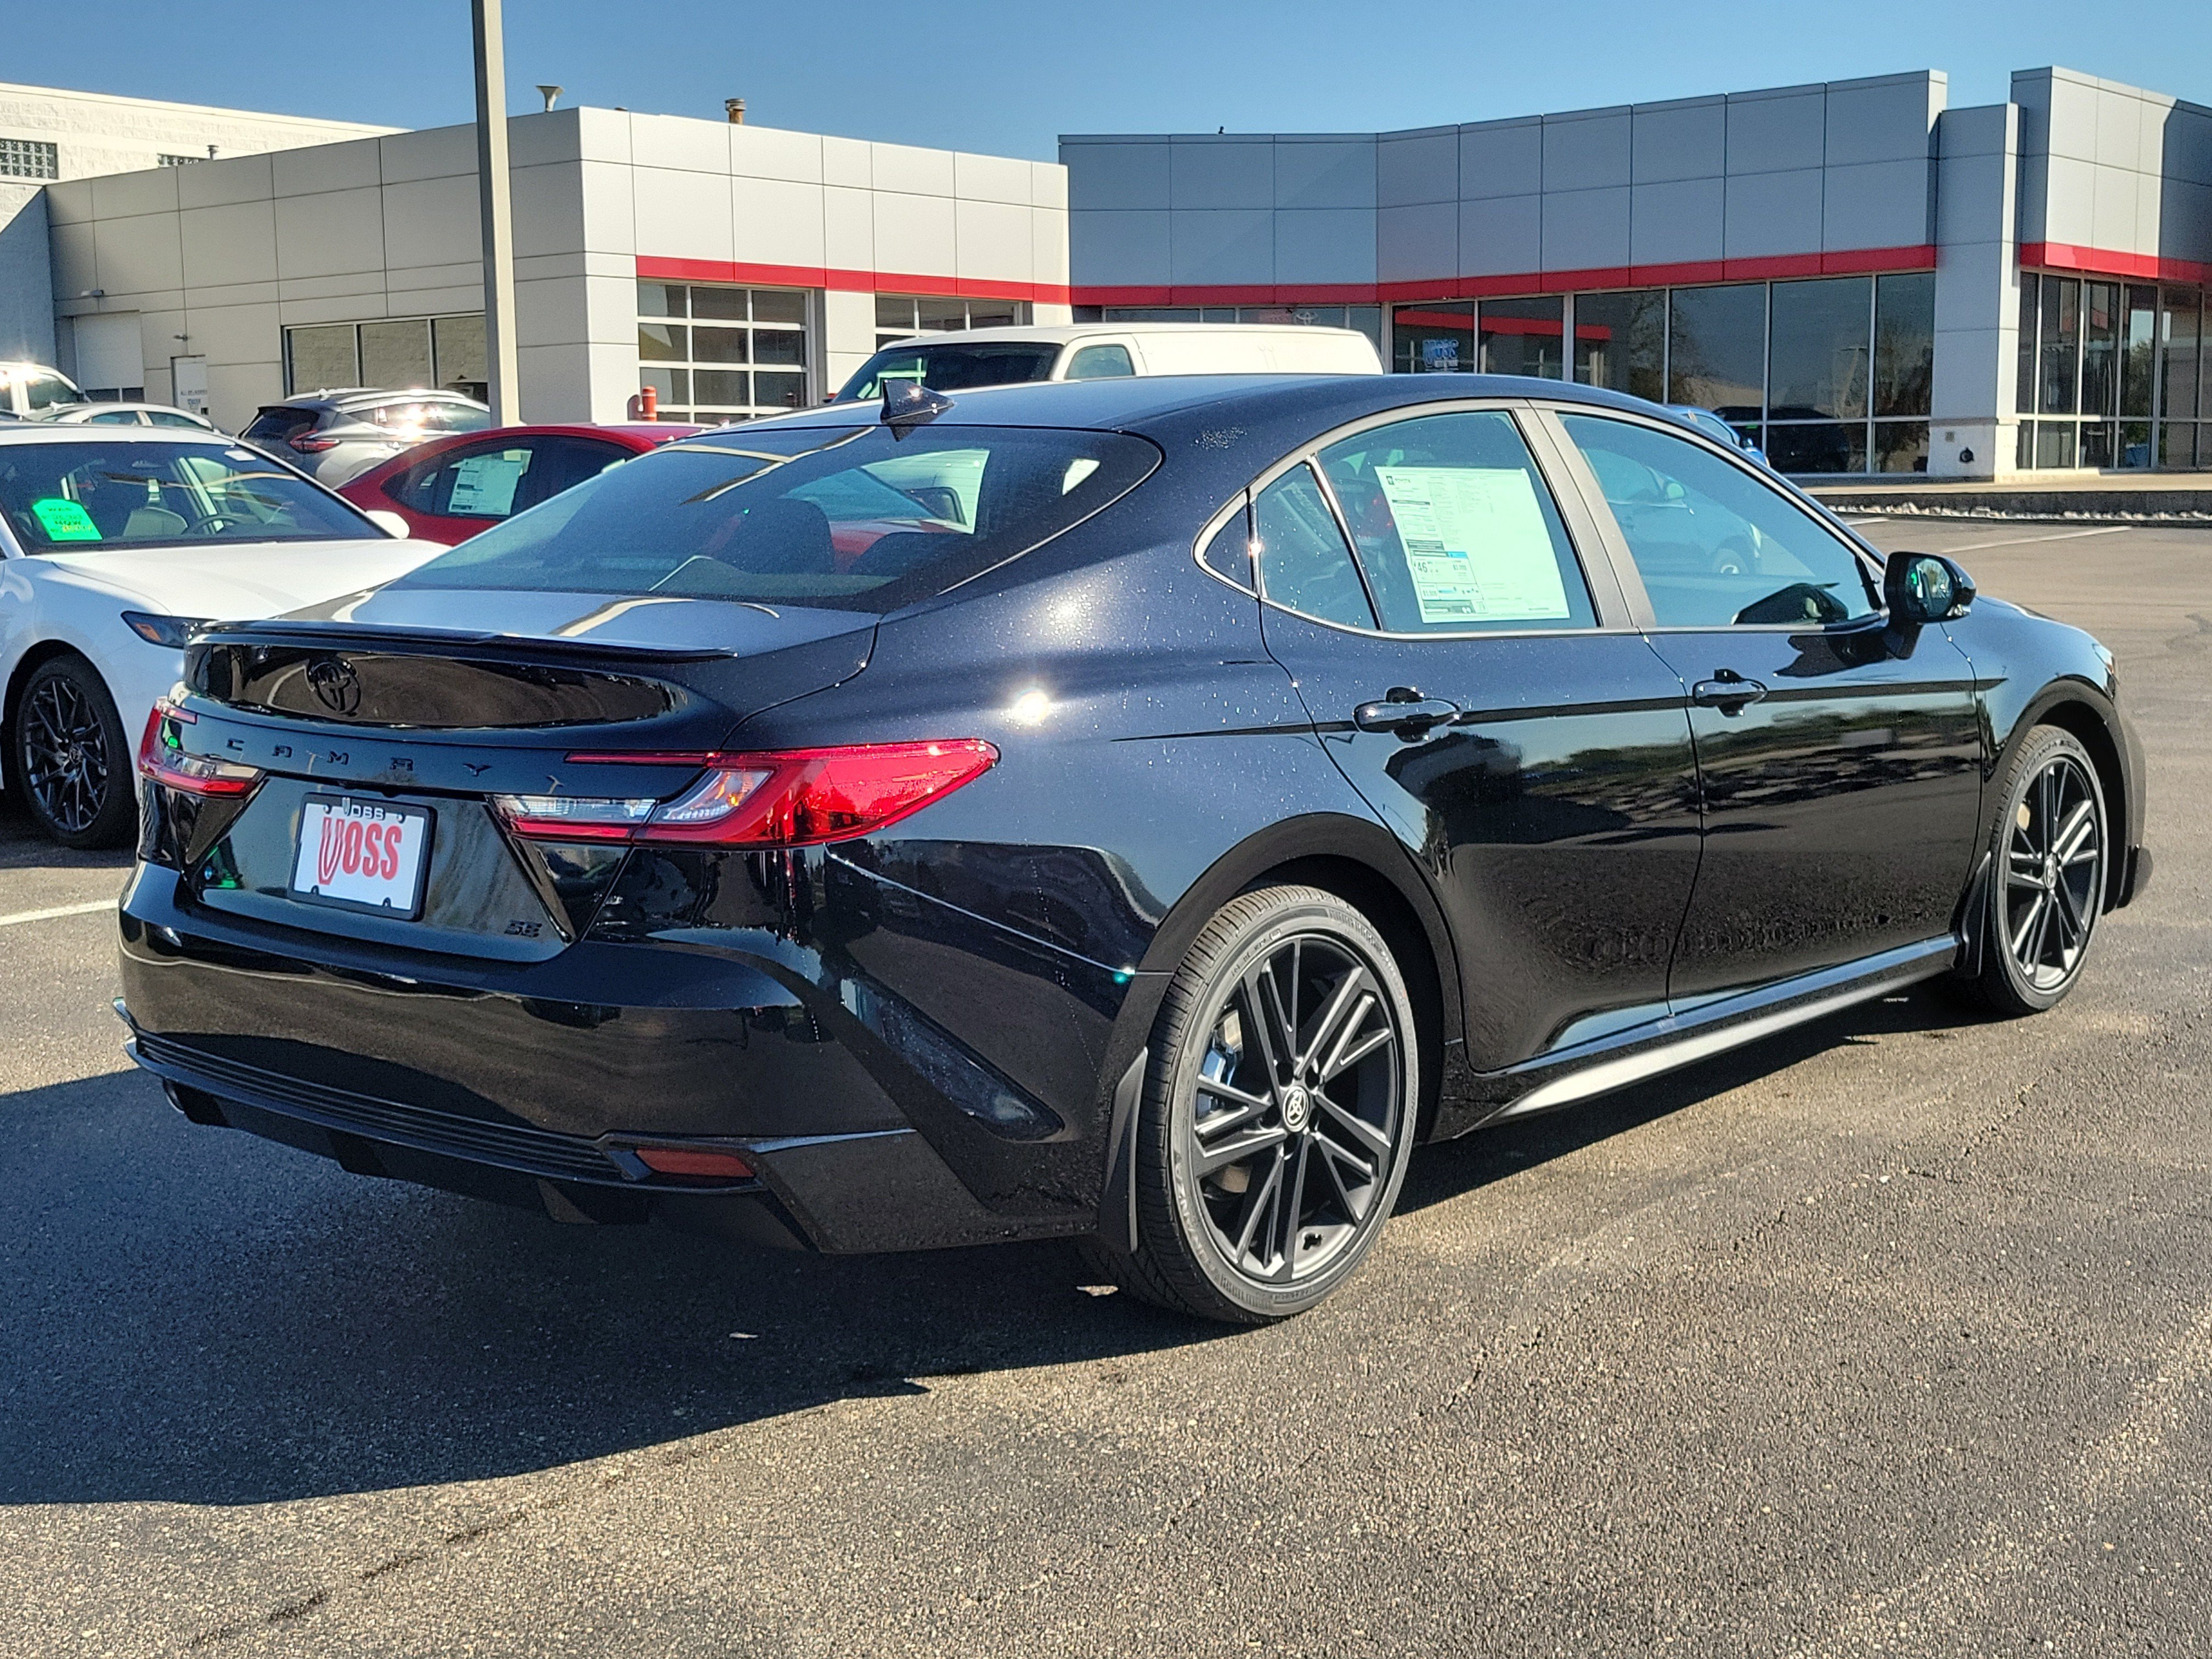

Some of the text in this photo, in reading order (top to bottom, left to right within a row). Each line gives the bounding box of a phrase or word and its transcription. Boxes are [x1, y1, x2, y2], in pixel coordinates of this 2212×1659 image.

[226, 737, 493, 777] CAMRY
[342, 797, 385, 821] VOSS
[318, 816, 402, 885] VOSS
[504, 919, 543, 938] SE
